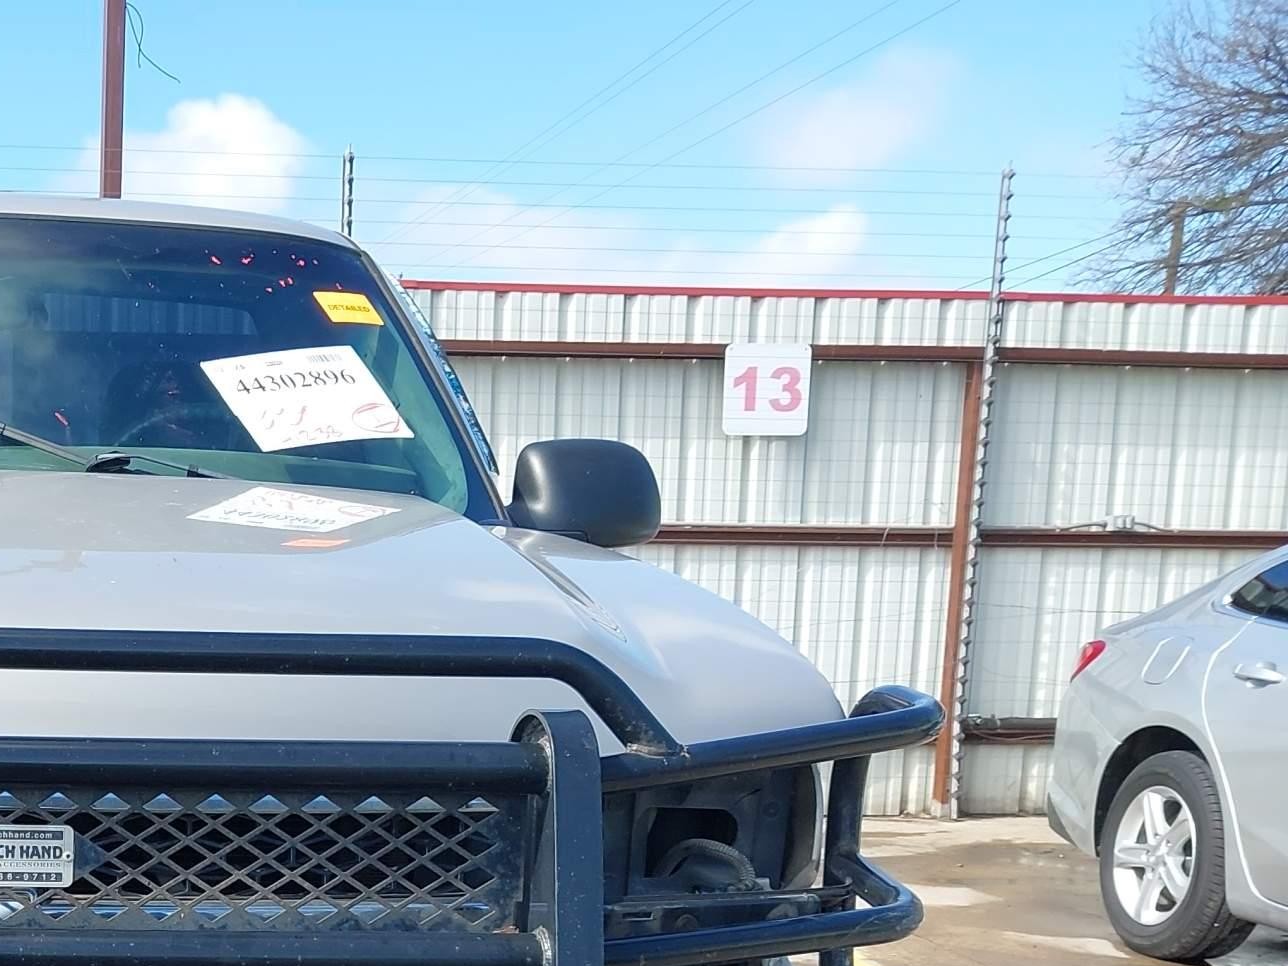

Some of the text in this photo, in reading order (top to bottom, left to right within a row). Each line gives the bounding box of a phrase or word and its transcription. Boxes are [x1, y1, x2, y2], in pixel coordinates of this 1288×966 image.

[236, 368, 356, 394] 44302896
[733, 366, 802, 412] 13
[19, 845, 63, 859] HAND
